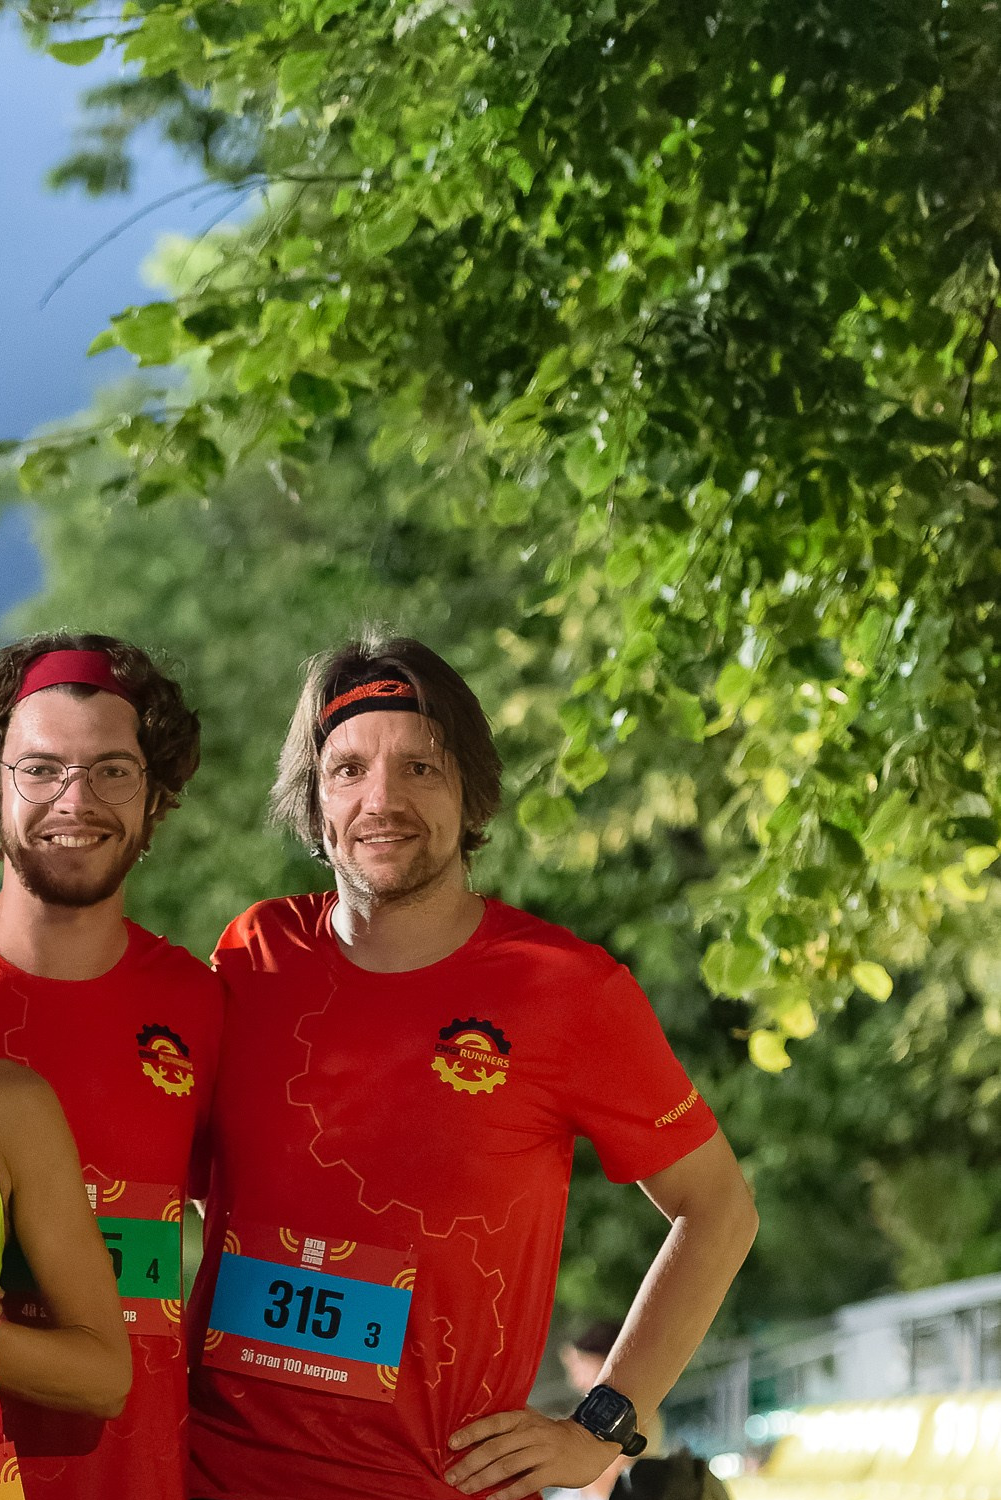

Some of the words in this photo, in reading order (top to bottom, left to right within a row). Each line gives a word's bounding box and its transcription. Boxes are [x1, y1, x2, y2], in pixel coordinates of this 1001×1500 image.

[146, 1258, 160, 1284] 4
[263, 1279, 345, 1340] 315
[364, 1322, 382, 1348] 3
[240, 1348, 255, 1363] 3й
[255, 1353, 281, 1369] этап
[283, 1358, 302, 1373] 100
[302, 1363, 348, 1383] метров
